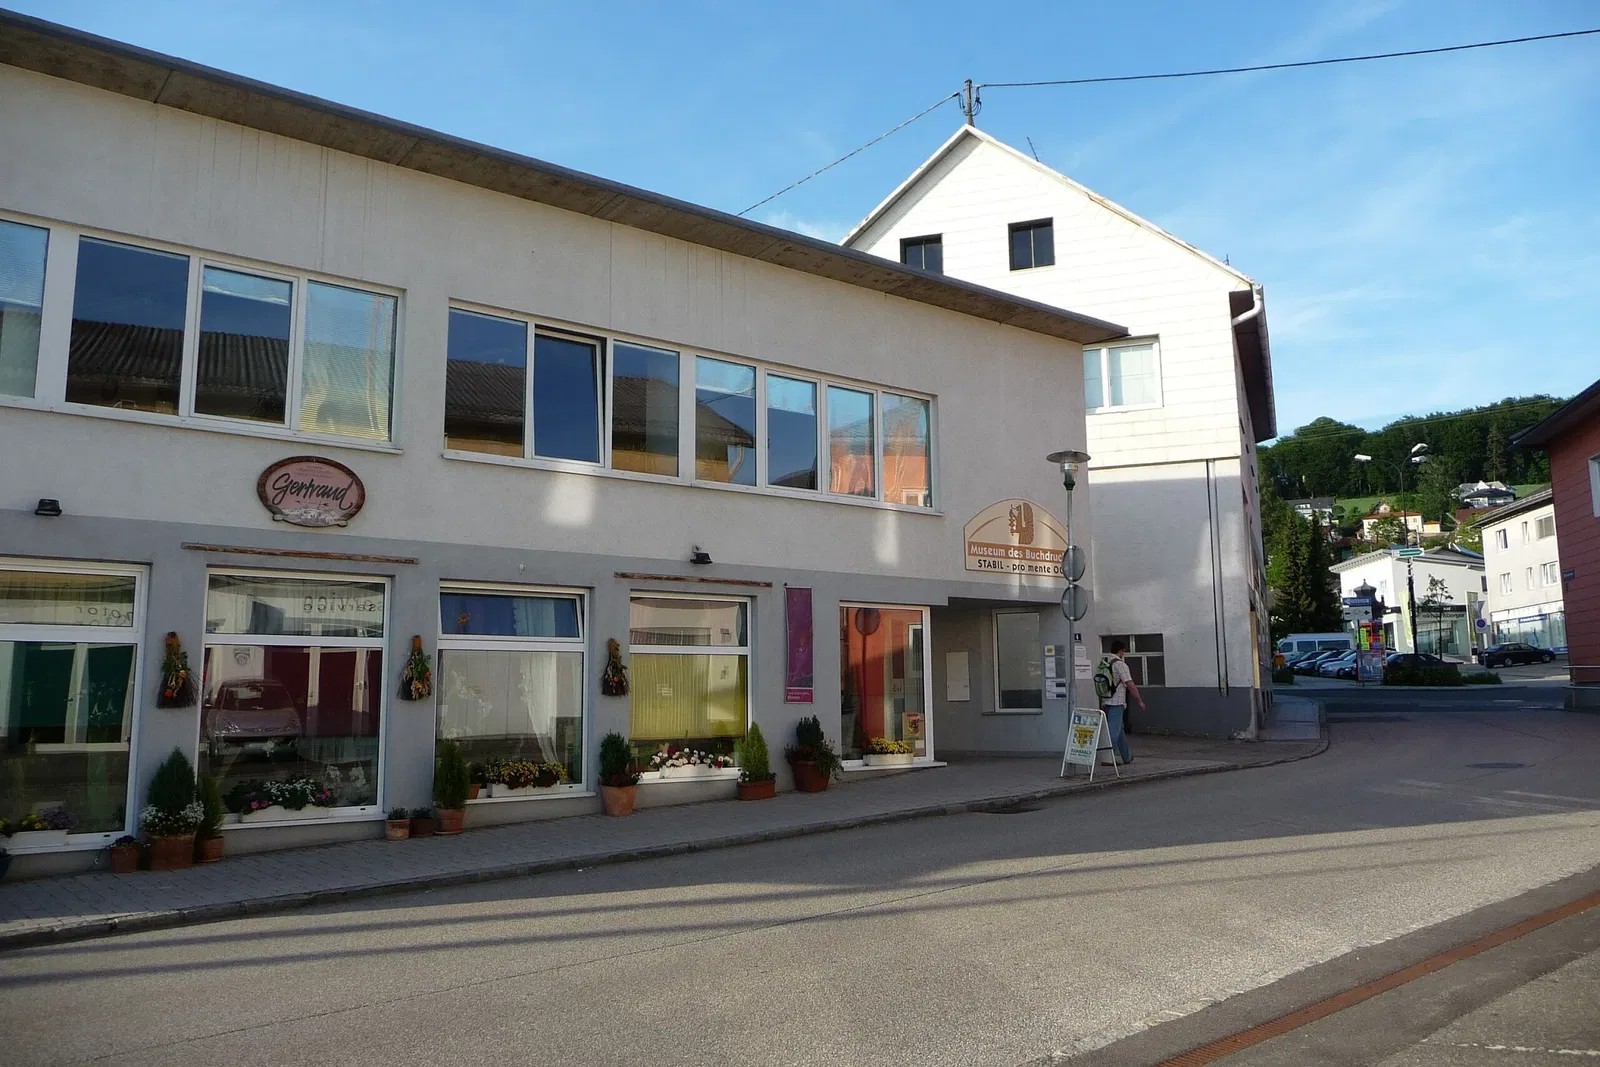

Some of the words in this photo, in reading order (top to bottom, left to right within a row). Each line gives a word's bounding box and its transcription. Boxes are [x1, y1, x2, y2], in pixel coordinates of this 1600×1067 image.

[272, 473, 354, 510] Gertraud
[970, 544, 1006, 557] Museum
[1008, 547, 1023, 558] des
[1025, 550, 1064, 562] Buchdruc
[977, 559, 1004, 570] STABIL
[1012, 562, 1026, 572] pro
[1027, 563, 1051, 574] mente
